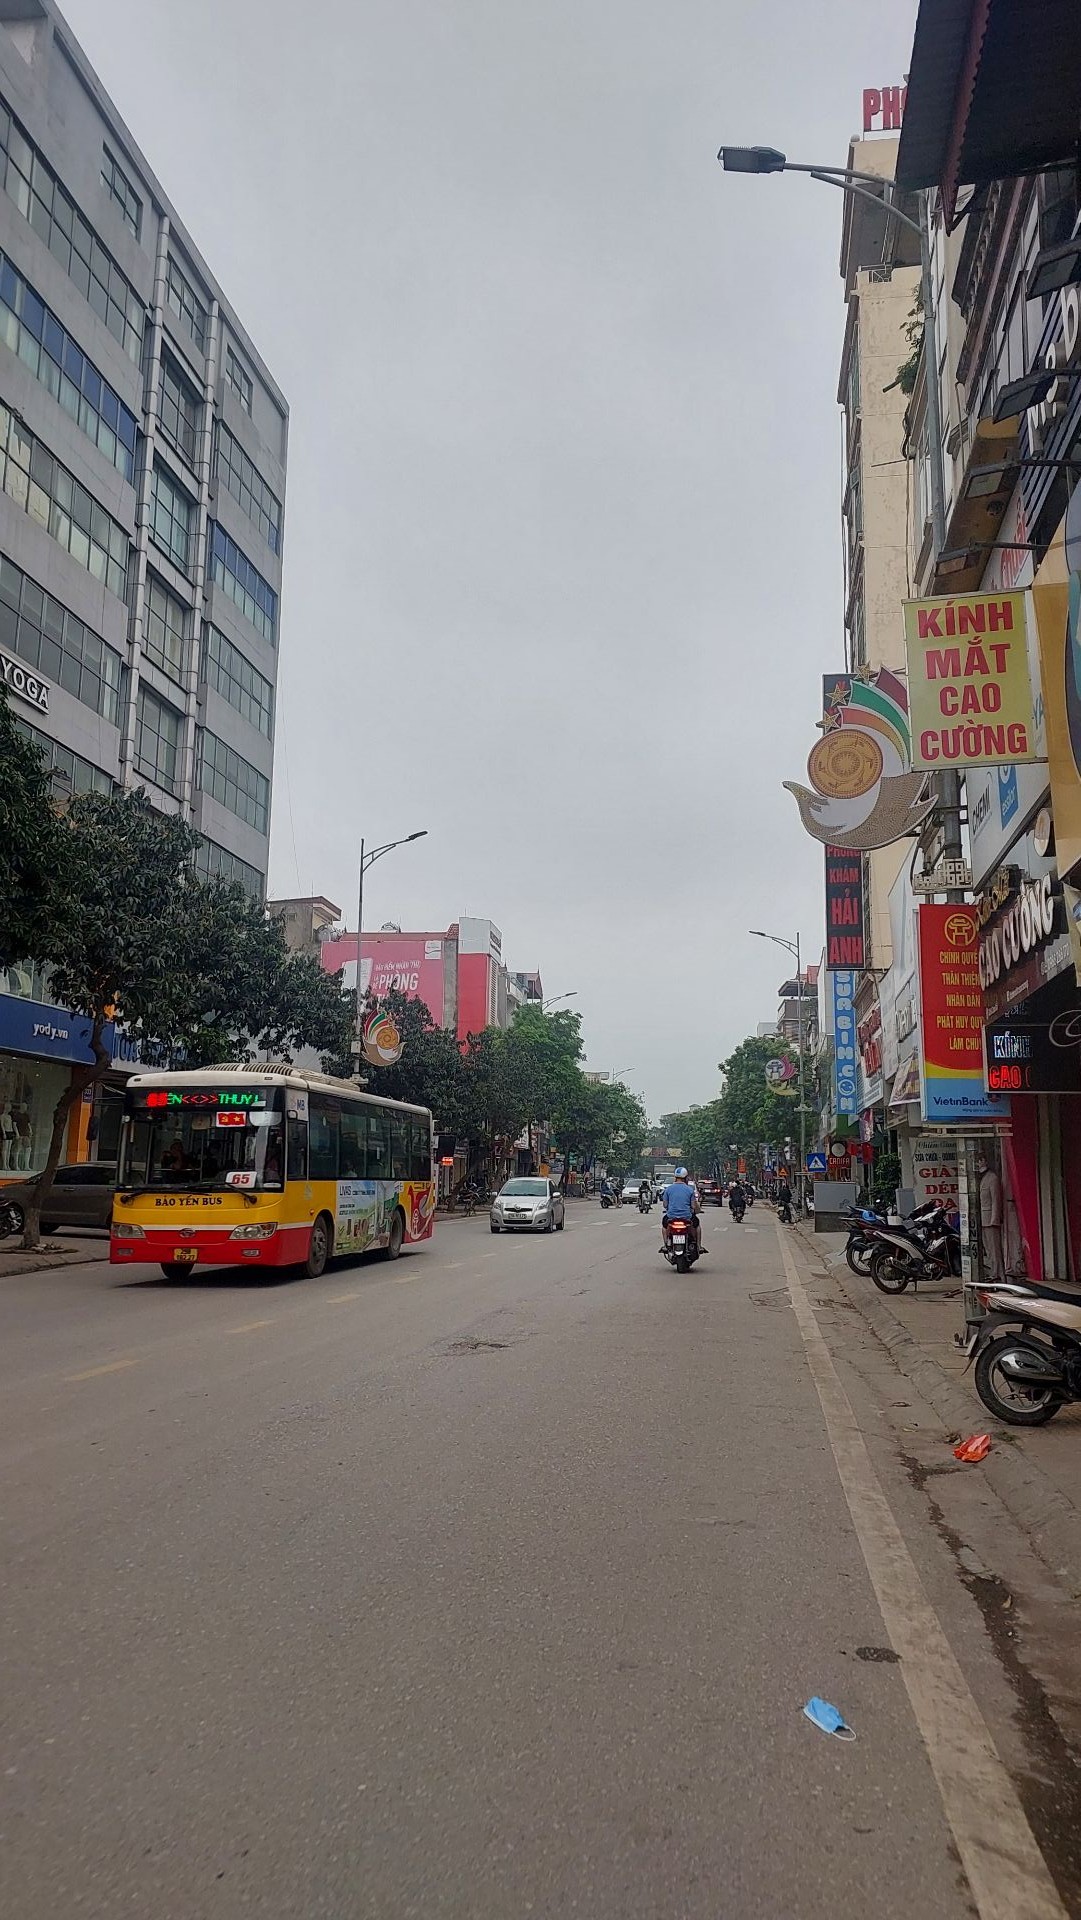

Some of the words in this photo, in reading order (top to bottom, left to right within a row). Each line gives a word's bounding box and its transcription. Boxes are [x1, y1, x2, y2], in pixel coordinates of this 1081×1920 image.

[863, 86, 908, 132] PH
[917, 600, 1014, 639] KÍNH
[925, 635, 1011, 680] MẮT
[0, 655, 49, 709] YOGA
[939, 682, 1002, 717] CAO
[920, 719, 1028, 761] CƯỜNG
[829, 936, 863, 964] ANH
[978, 928, 1000, 992] CAO
[379, 970, 419, 991] PHÒNG
[33, 1022, 69, 1040] yody.vn
[955, 1016, 969, 1029] HUY
[989, 1065, 1022, 1089] CAO
[933, 1096, 988, 1106] VietinBank
[829, 1157, 850, 1165] CANIFA
[231, 1174, 250, 1185] 65
[202, 1197, 223, 1206] BUS
